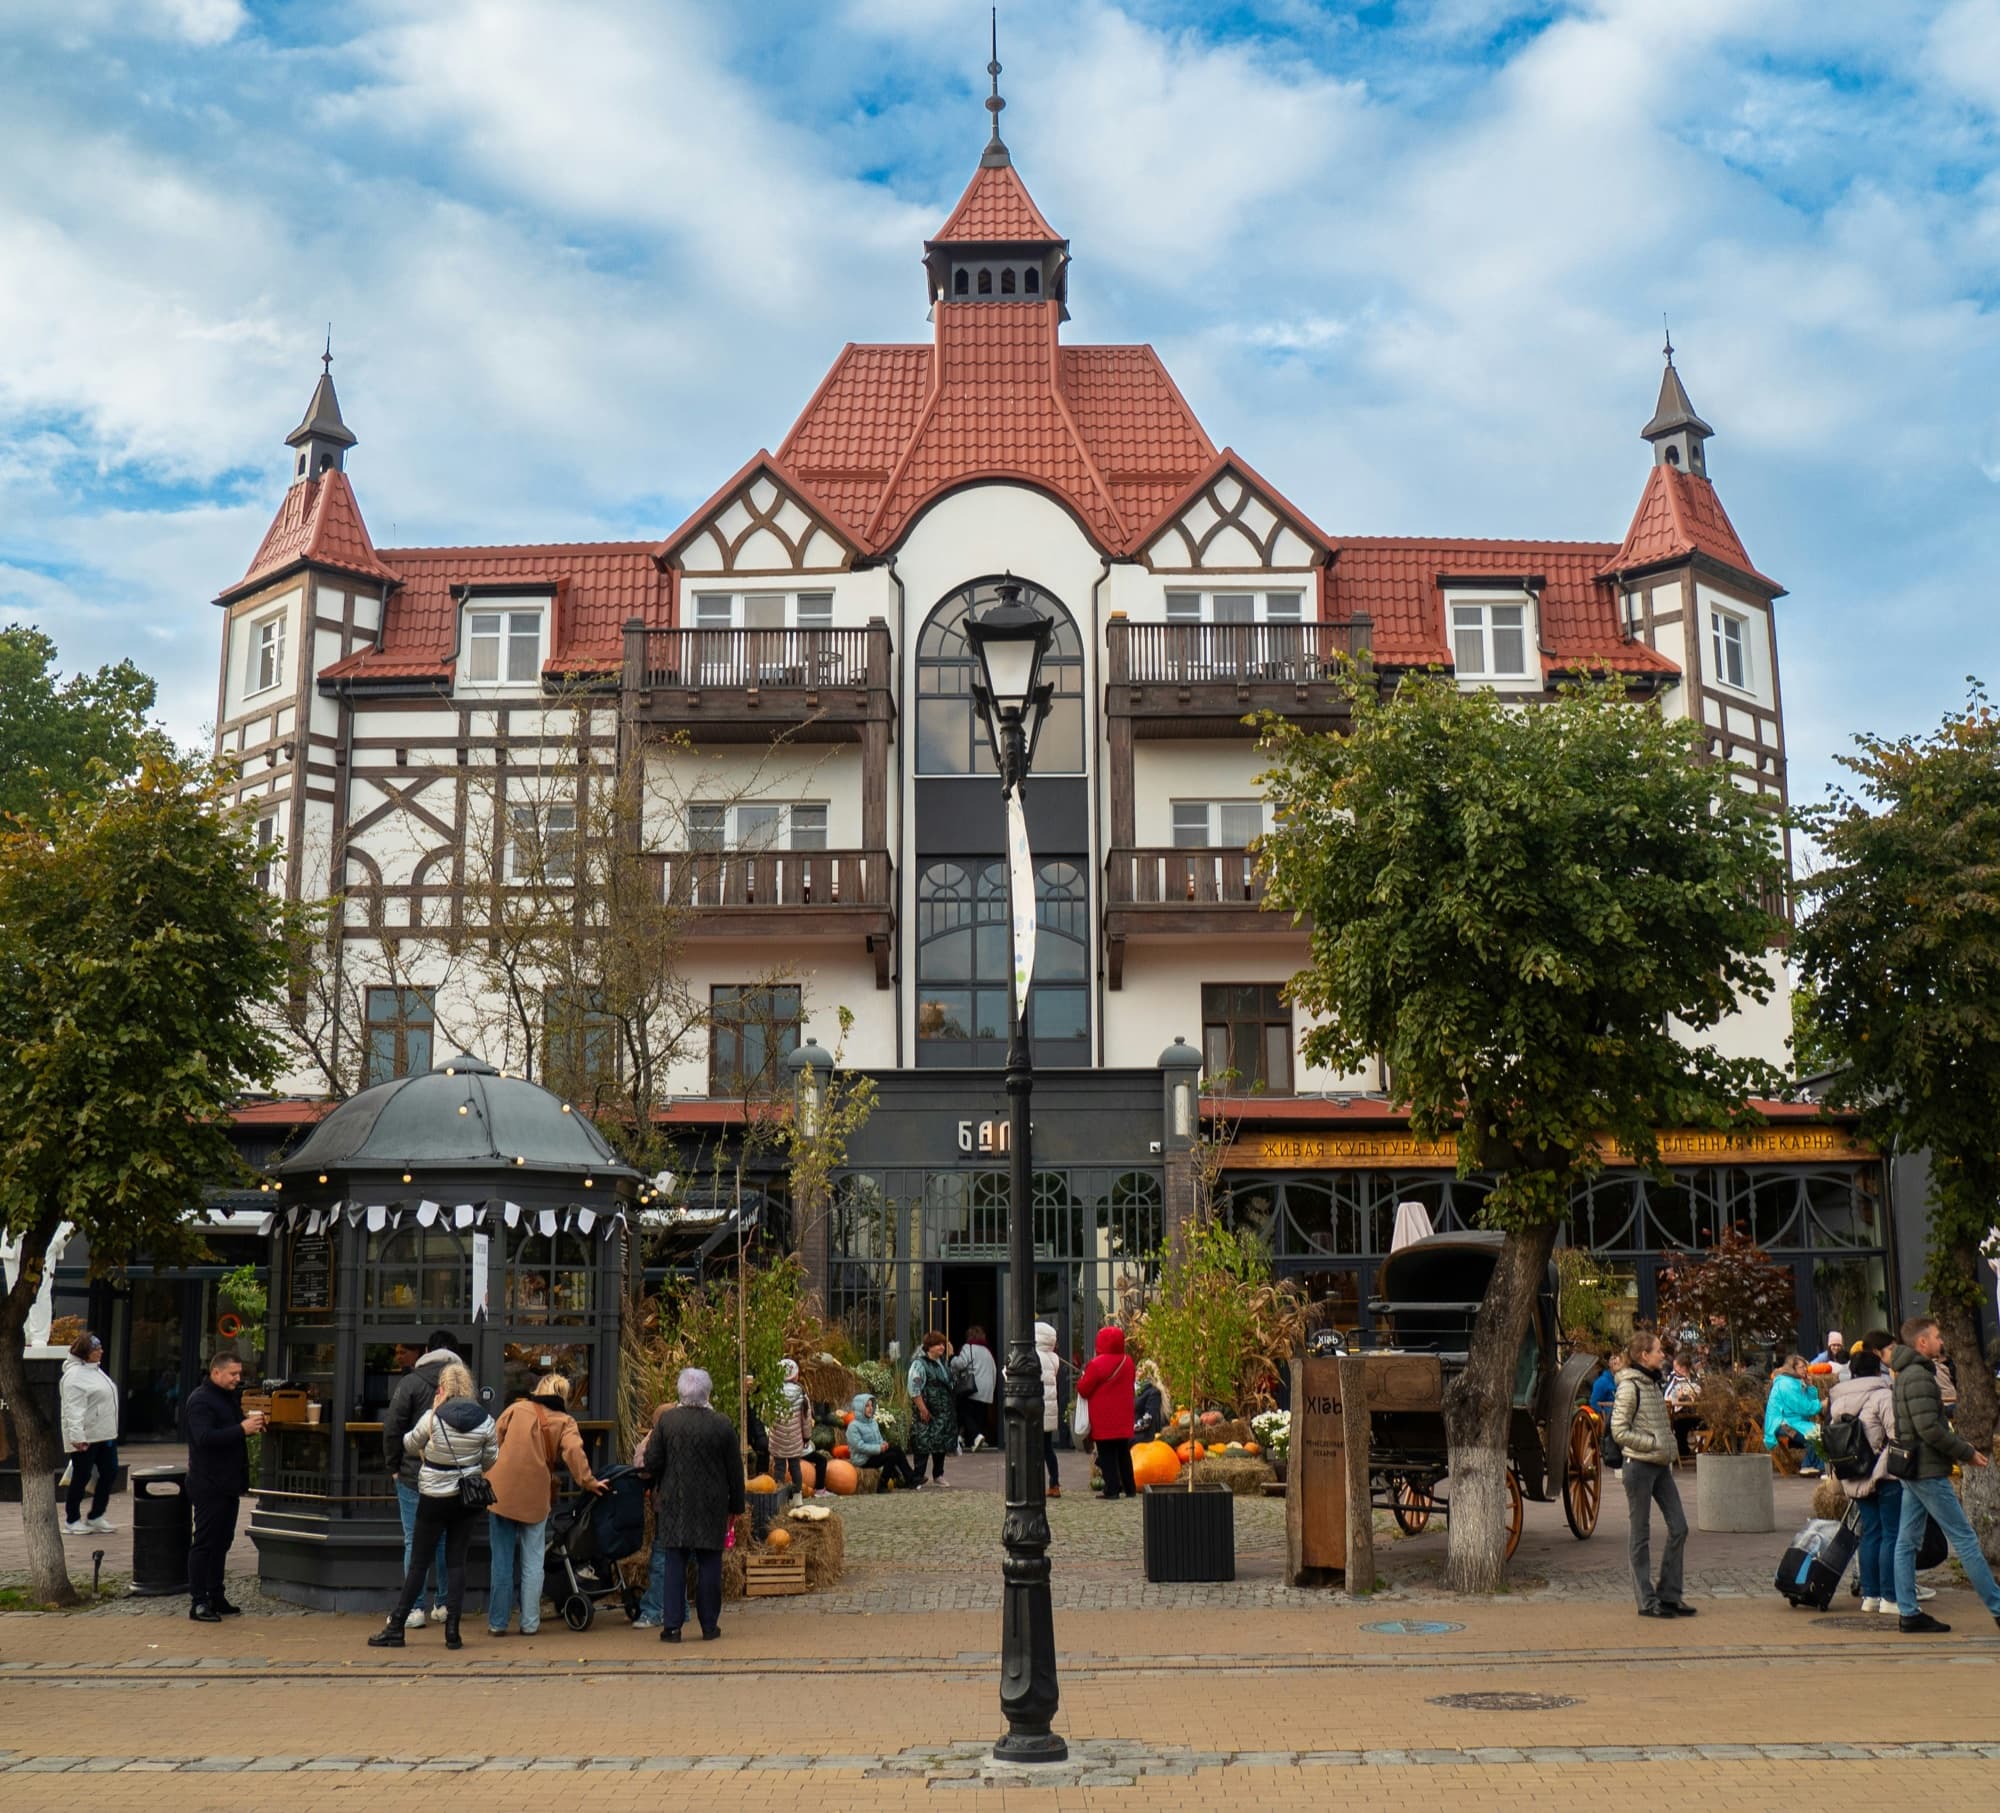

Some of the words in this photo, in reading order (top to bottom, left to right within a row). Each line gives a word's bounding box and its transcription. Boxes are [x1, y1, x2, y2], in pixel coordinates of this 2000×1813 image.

[958, 1120, 1034, 1152] БАЛ
[1755, 1134, 1835, 1152] ПЕКАРНЯ
[1264, 1142, 1325, 1158] ЖИВАЯ
[1335, 1141, 1422, 1157] КУЛЬТУРА
[1432, 1141, 1460, 1157] ХЛ
